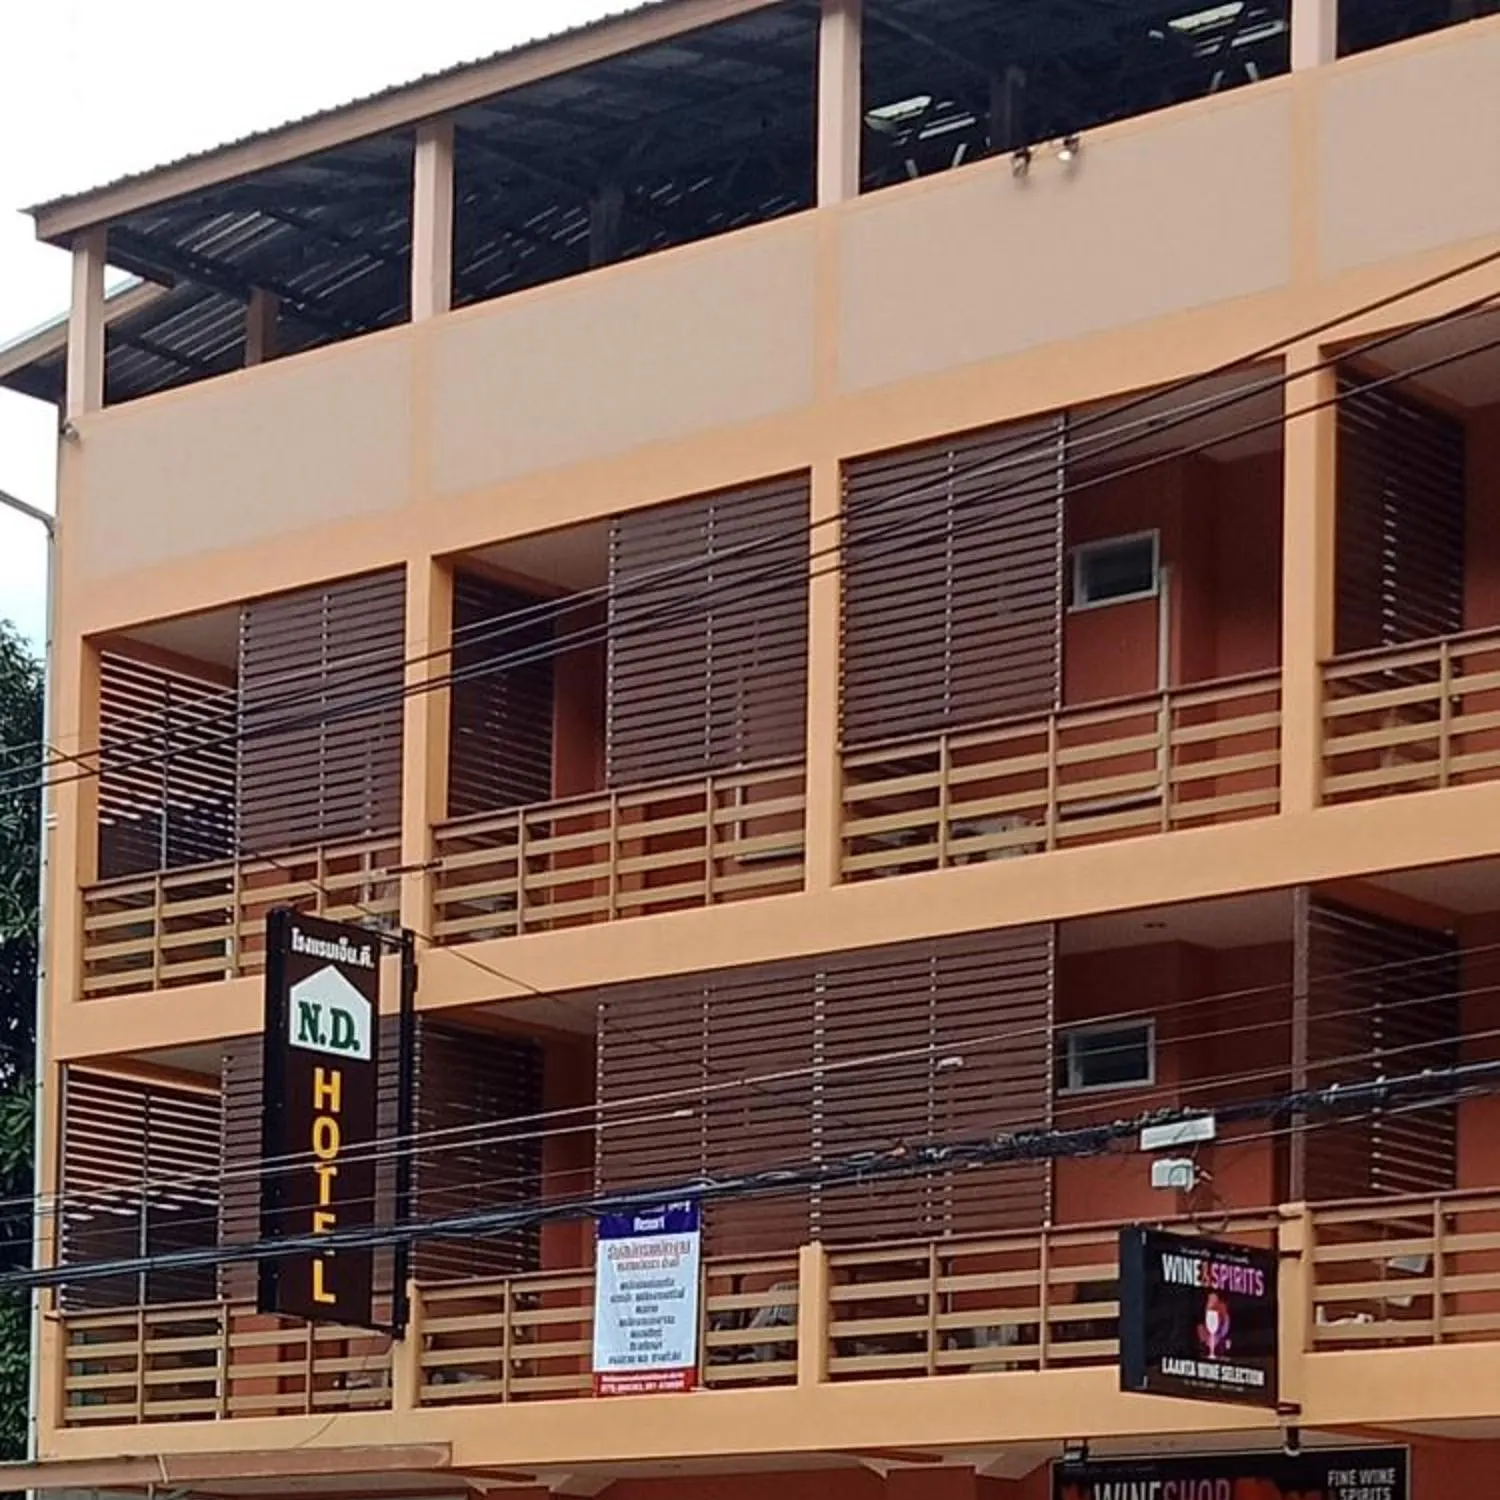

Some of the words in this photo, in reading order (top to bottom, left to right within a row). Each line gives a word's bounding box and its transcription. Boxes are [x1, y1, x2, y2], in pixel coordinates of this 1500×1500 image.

[297, 1000, 361, 1051] N.D.
[1327, 1468, 1357, 1488] FINE
[1359, 1467, 1396, 1486] WINE
